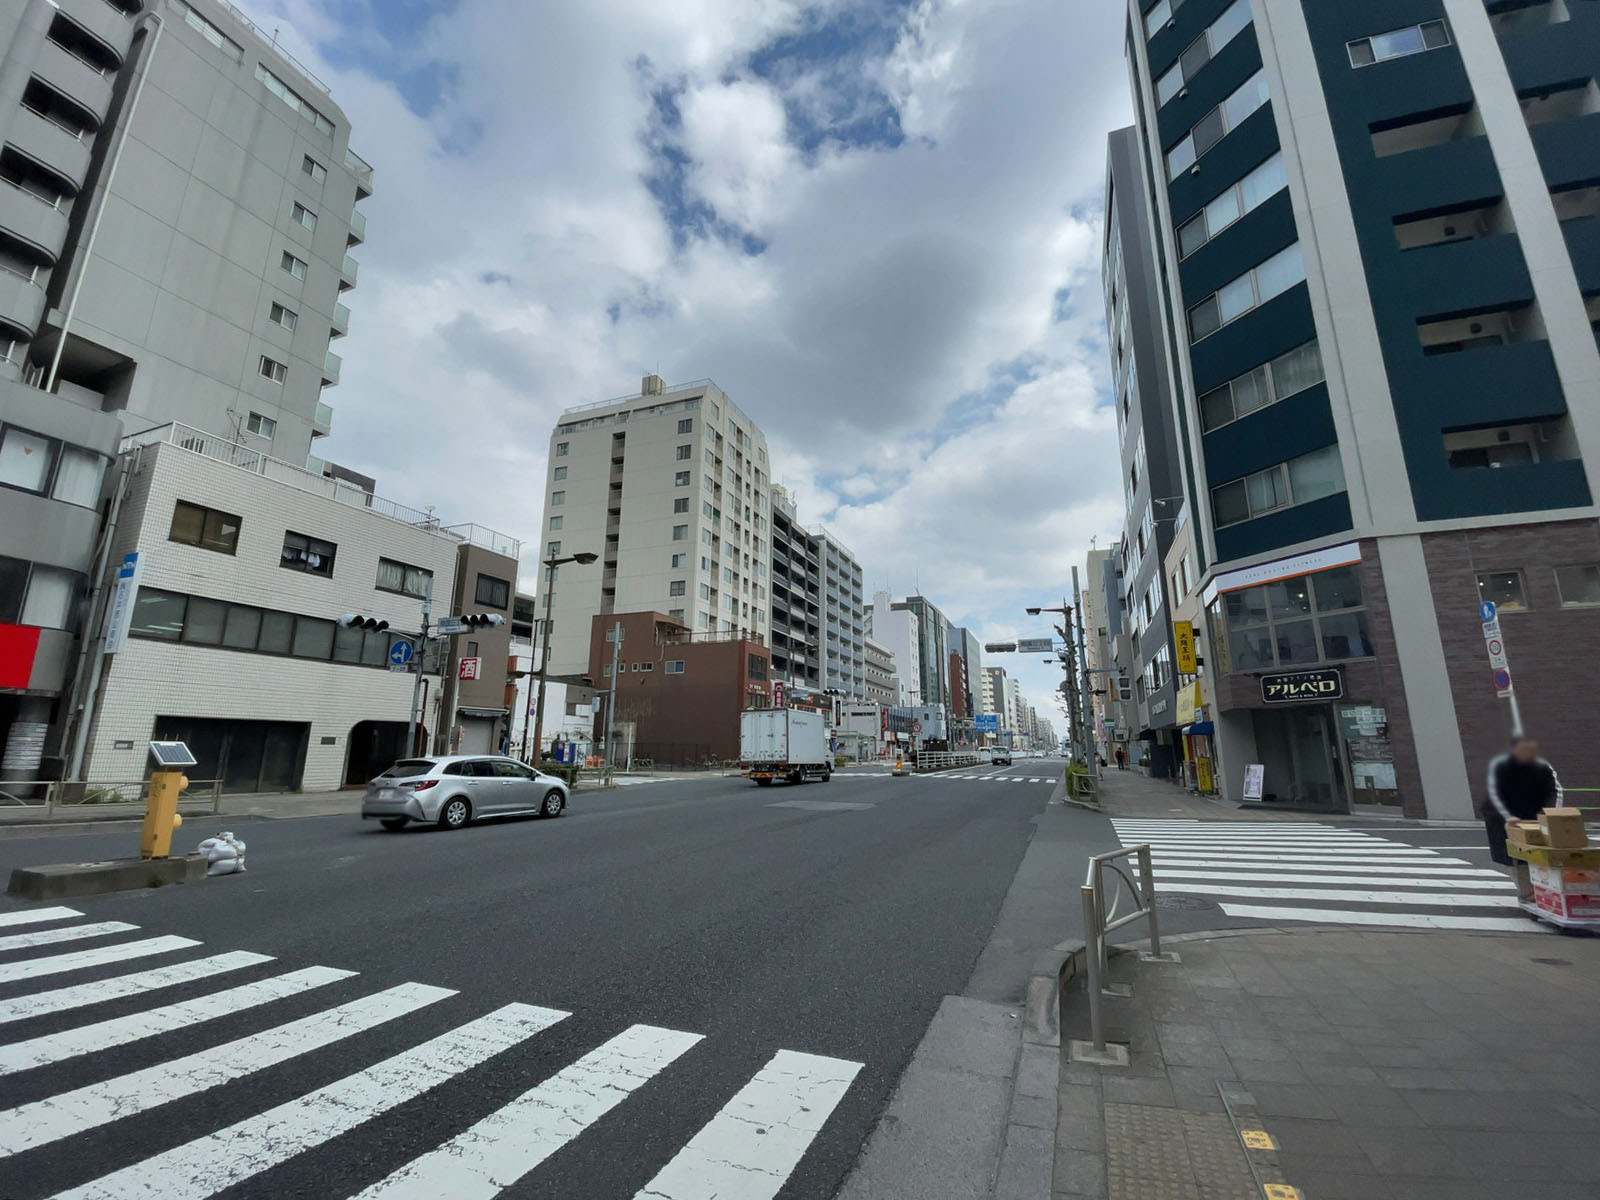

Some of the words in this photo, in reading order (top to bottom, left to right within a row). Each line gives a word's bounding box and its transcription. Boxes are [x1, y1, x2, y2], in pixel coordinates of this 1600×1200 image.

[460, 659, 476, 678] 酒
[1266, 680, 1336, 696] アルベロ
